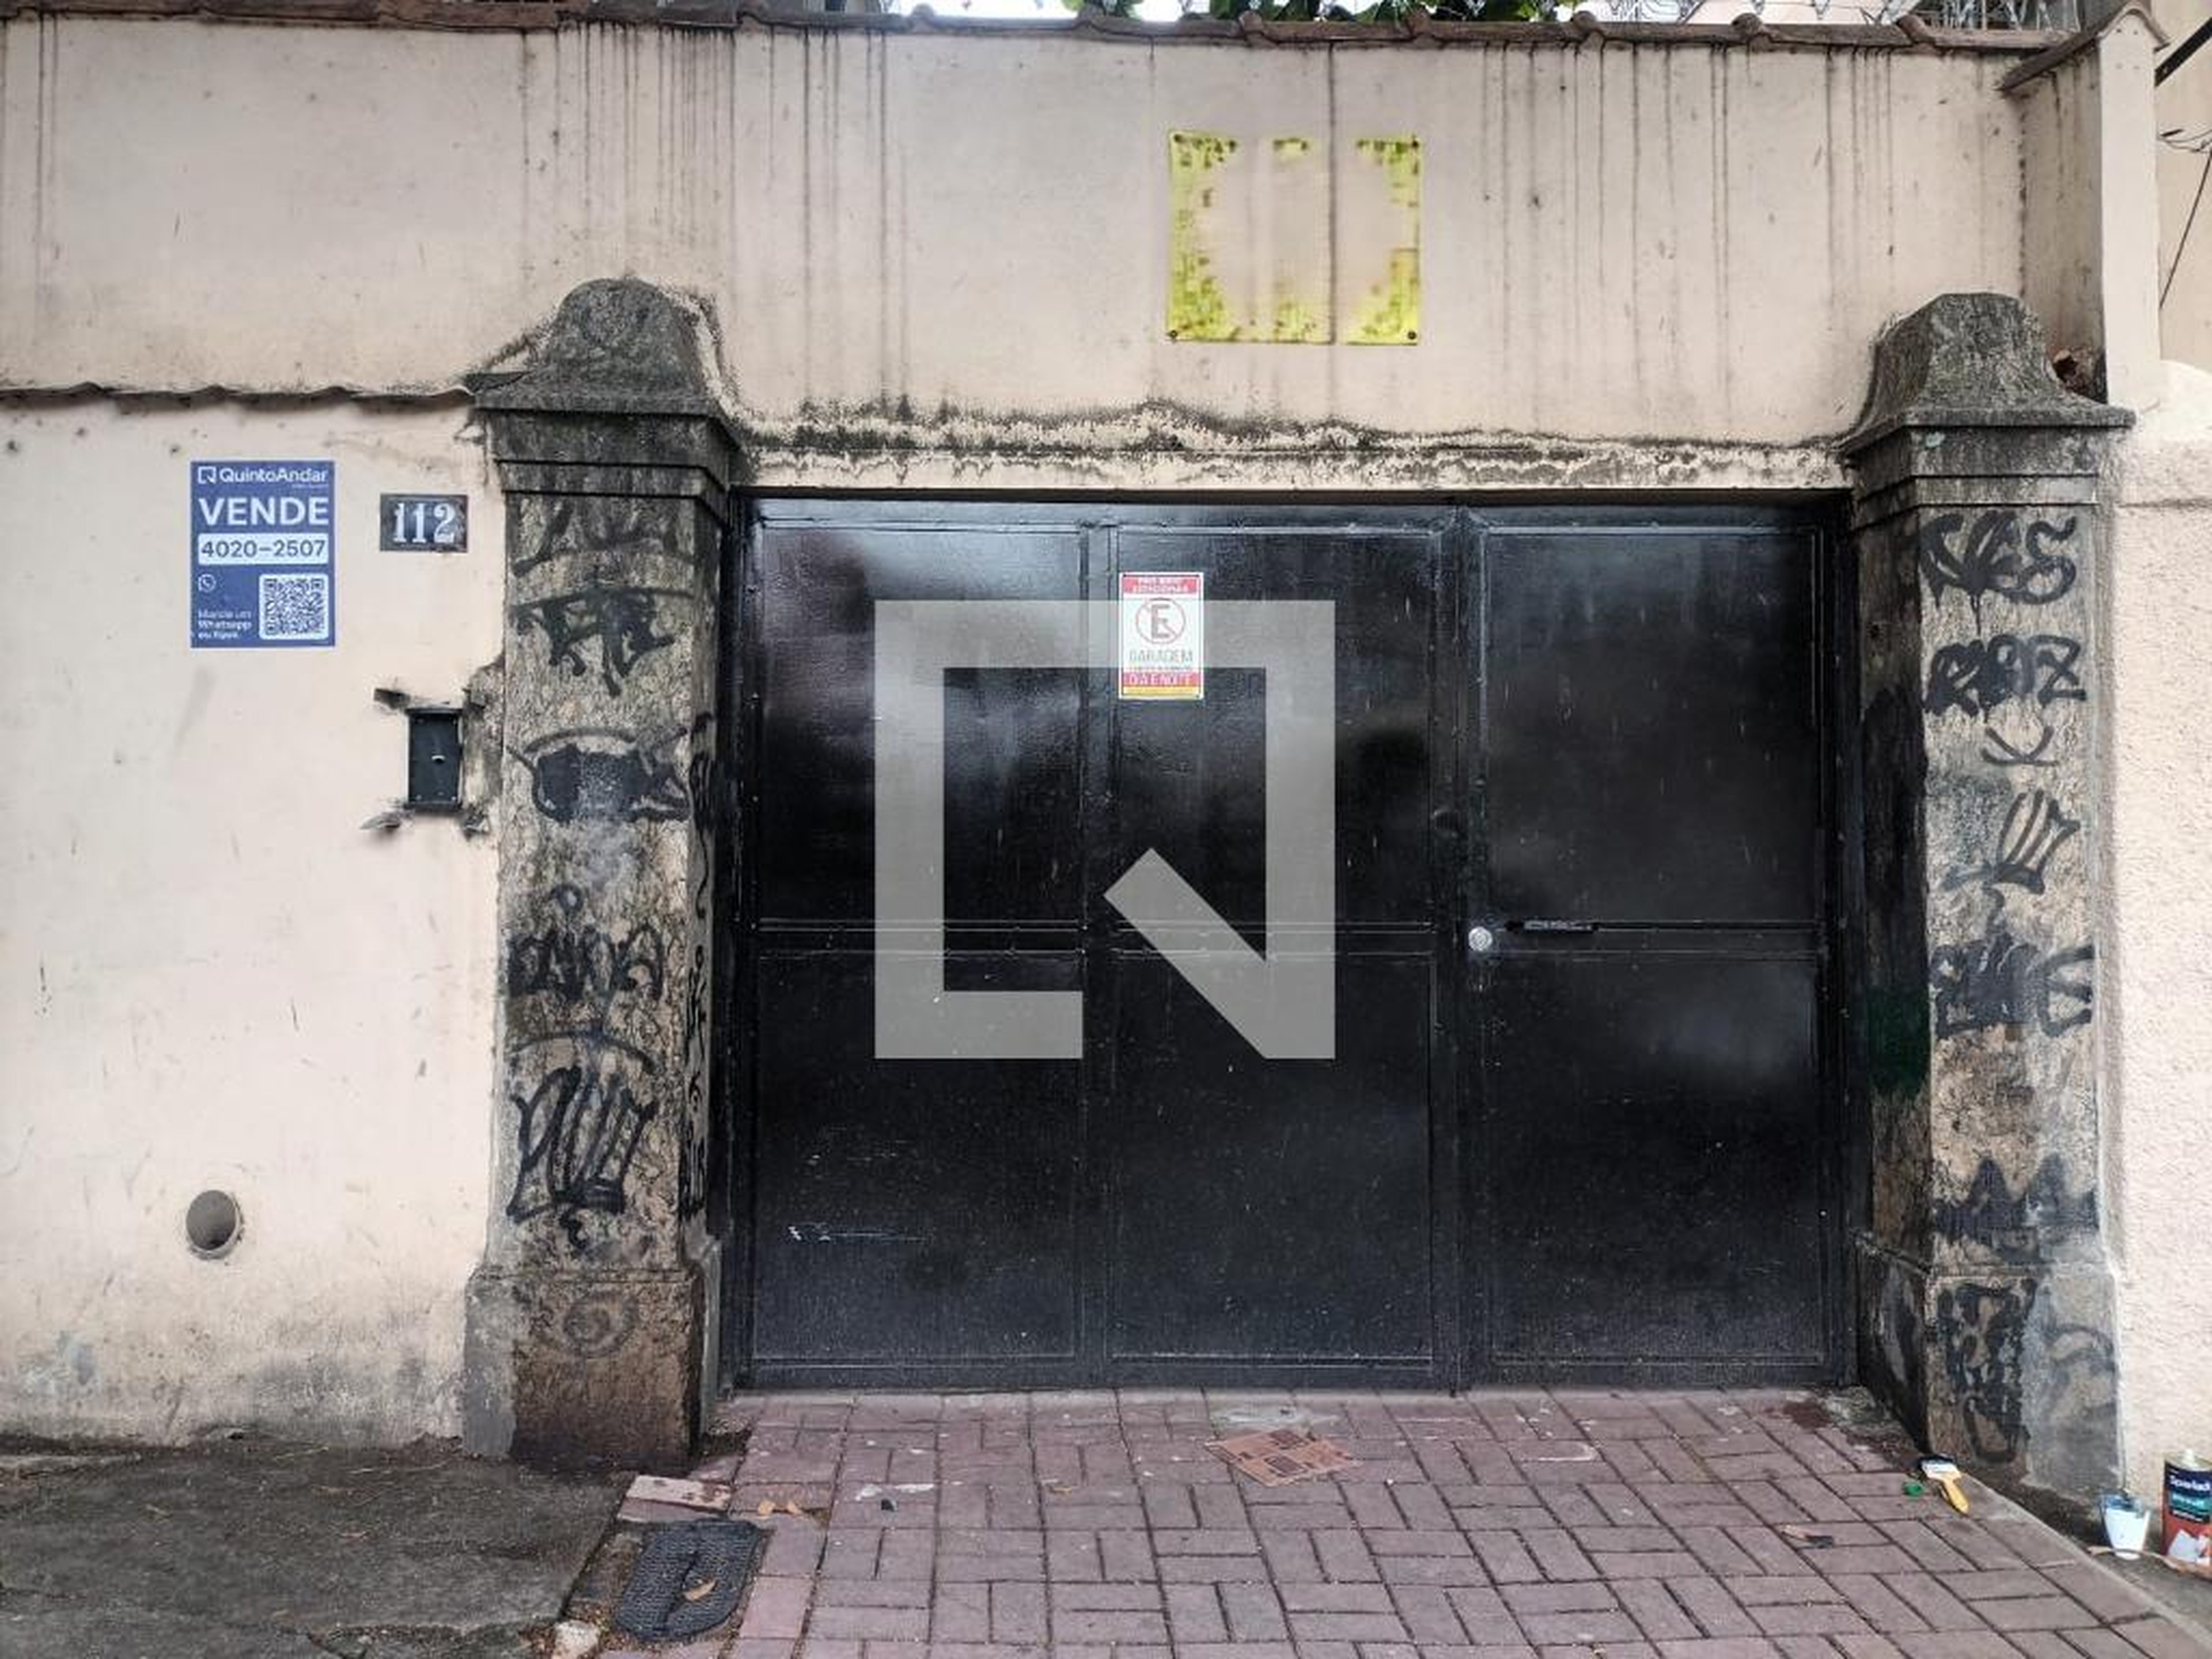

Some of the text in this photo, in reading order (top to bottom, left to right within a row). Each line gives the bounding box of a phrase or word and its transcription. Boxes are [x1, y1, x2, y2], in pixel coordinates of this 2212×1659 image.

[219, 467, 328, 483] QuintoAndar
[198, 497, 329, 525] VENDE
[393, 502, 456, 543] 112
[202, 539, 326, 558] 4020-2507
